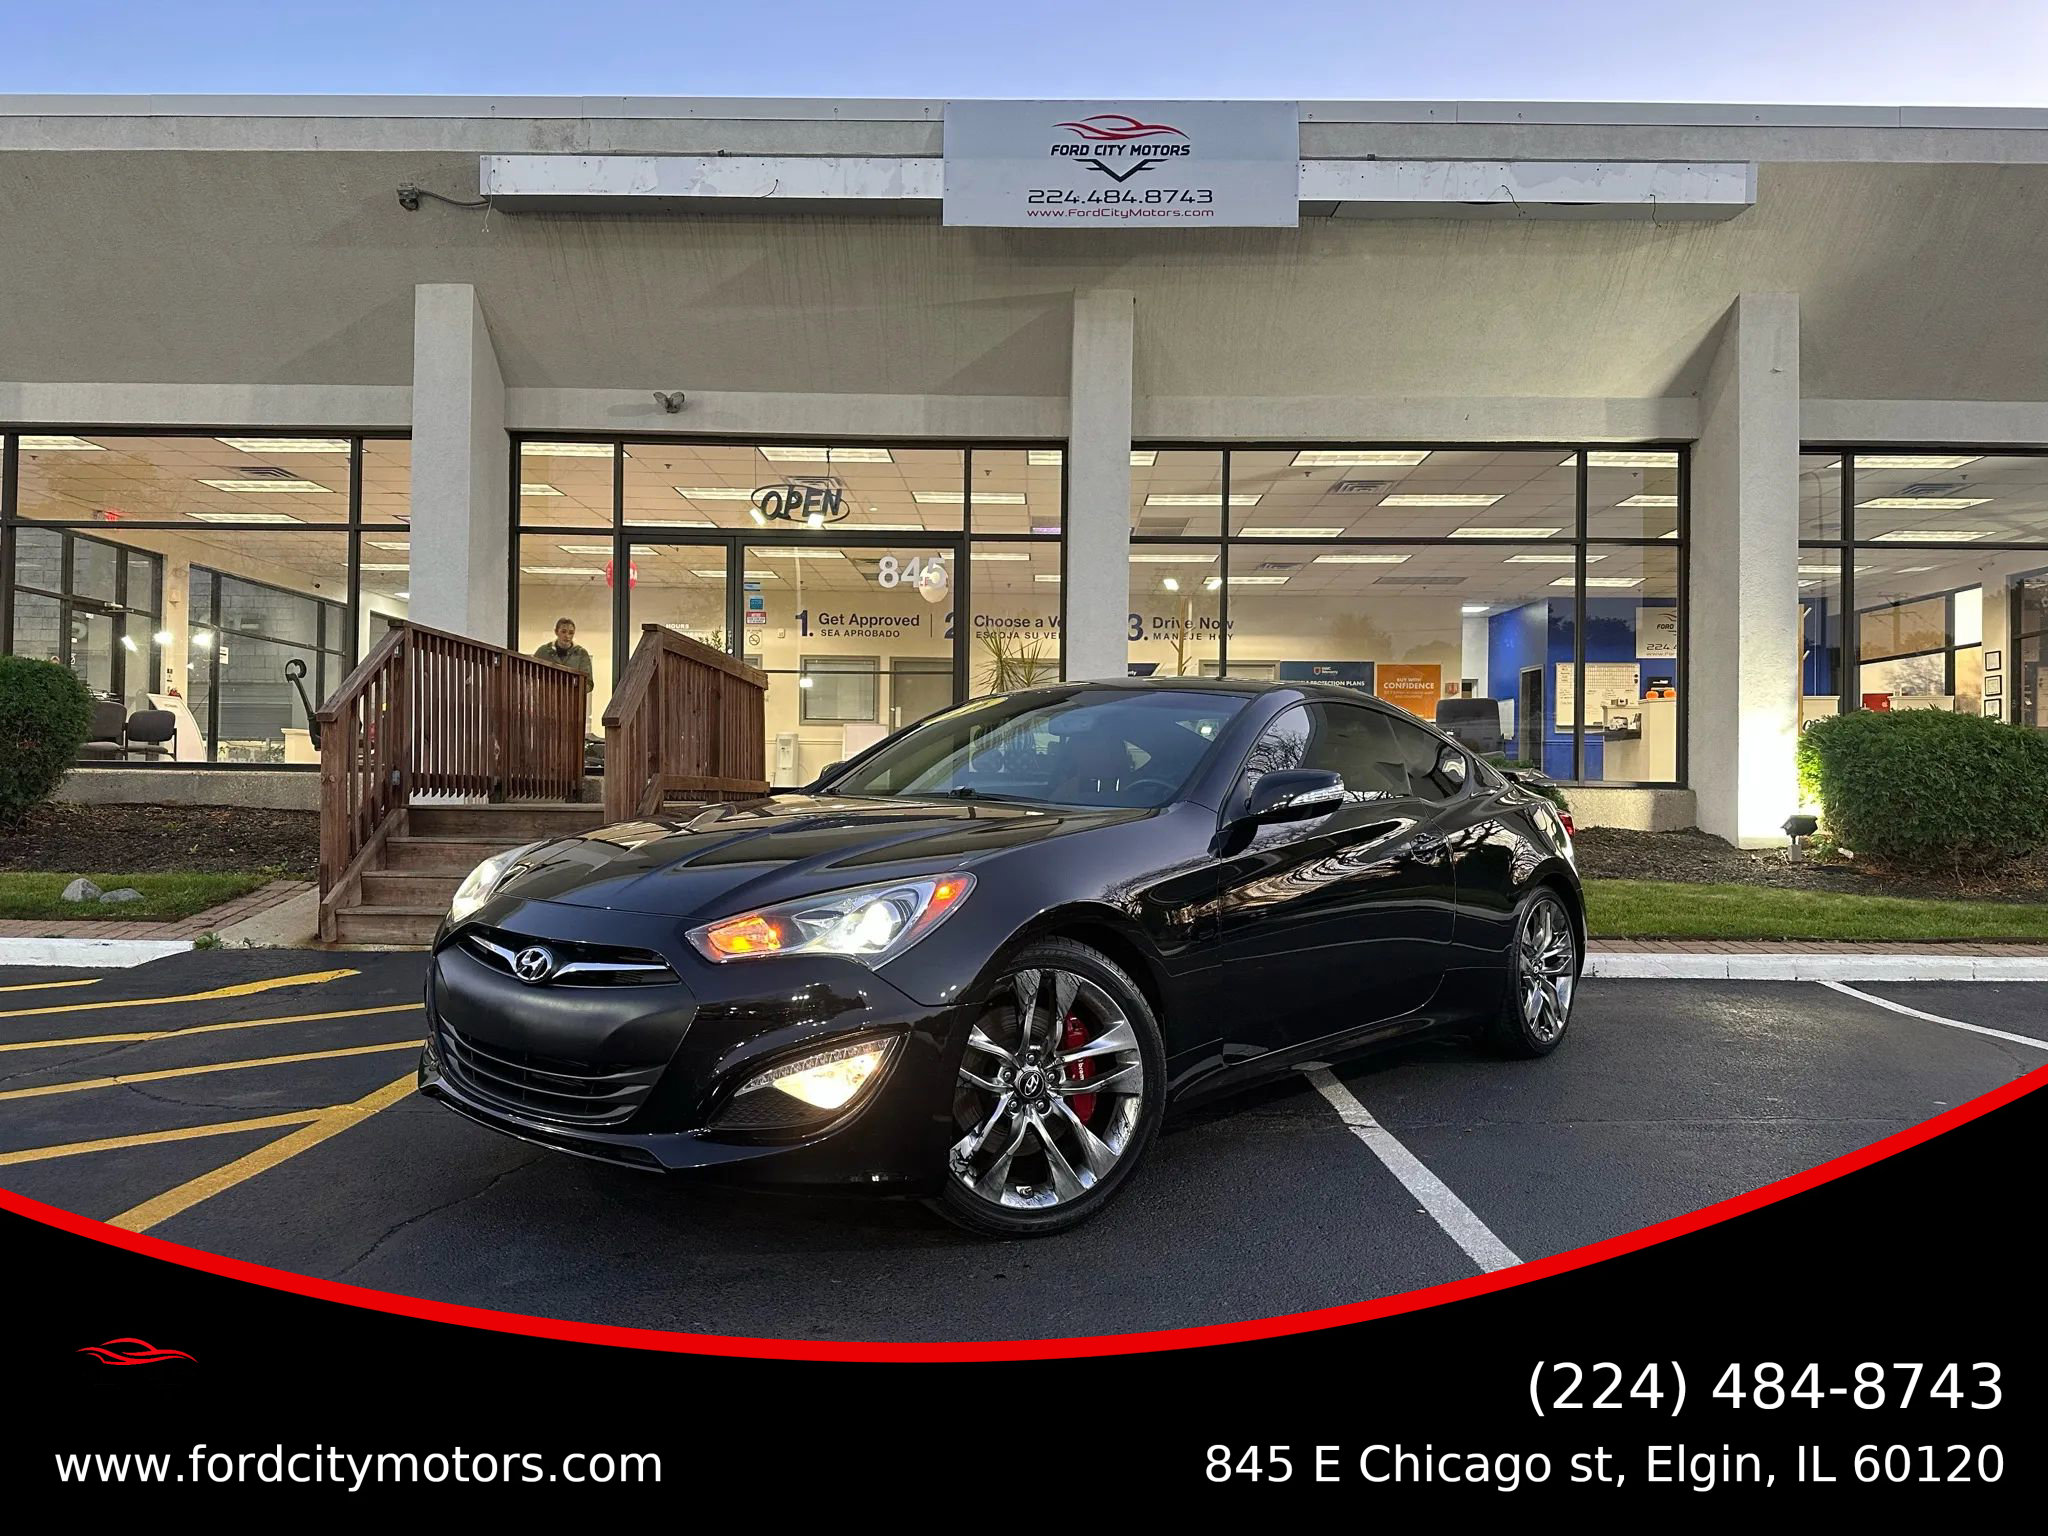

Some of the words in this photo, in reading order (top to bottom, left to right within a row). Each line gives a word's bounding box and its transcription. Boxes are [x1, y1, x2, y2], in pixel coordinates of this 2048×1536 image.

[1050, 144, 1090, 157] FORD
[1094, 144, 1127, 157] CITY
[1129, 144, 1191, 157] MOTORS
[1028, 189, 1213, 204] 224.484.8743
[1027, 207, 1214, 219] www.FordCityMotors.com
[761, 485, 842, 521] OPEN
[878, 556, 946, 588] 845
[795, 609, 814, 638] 1.
[818, 612, 845, 626] Get
[848, 613, 920, 628] Approved
[974, 614, 1031, 628] Choose
[1035, 617, 1044, 628] a
[1128, 613, 1149, 641] 3.
[820, 629, 840, 637] SEA
[844, 629, 900, 638] APROBADO
[976, 631, 1020, 640] ESCOJA
[1024, 632, 1039, 640] SU
[1043, 631, 1061, 640] VE
[1383, 682, 1435, 690] CONFIDENCE
